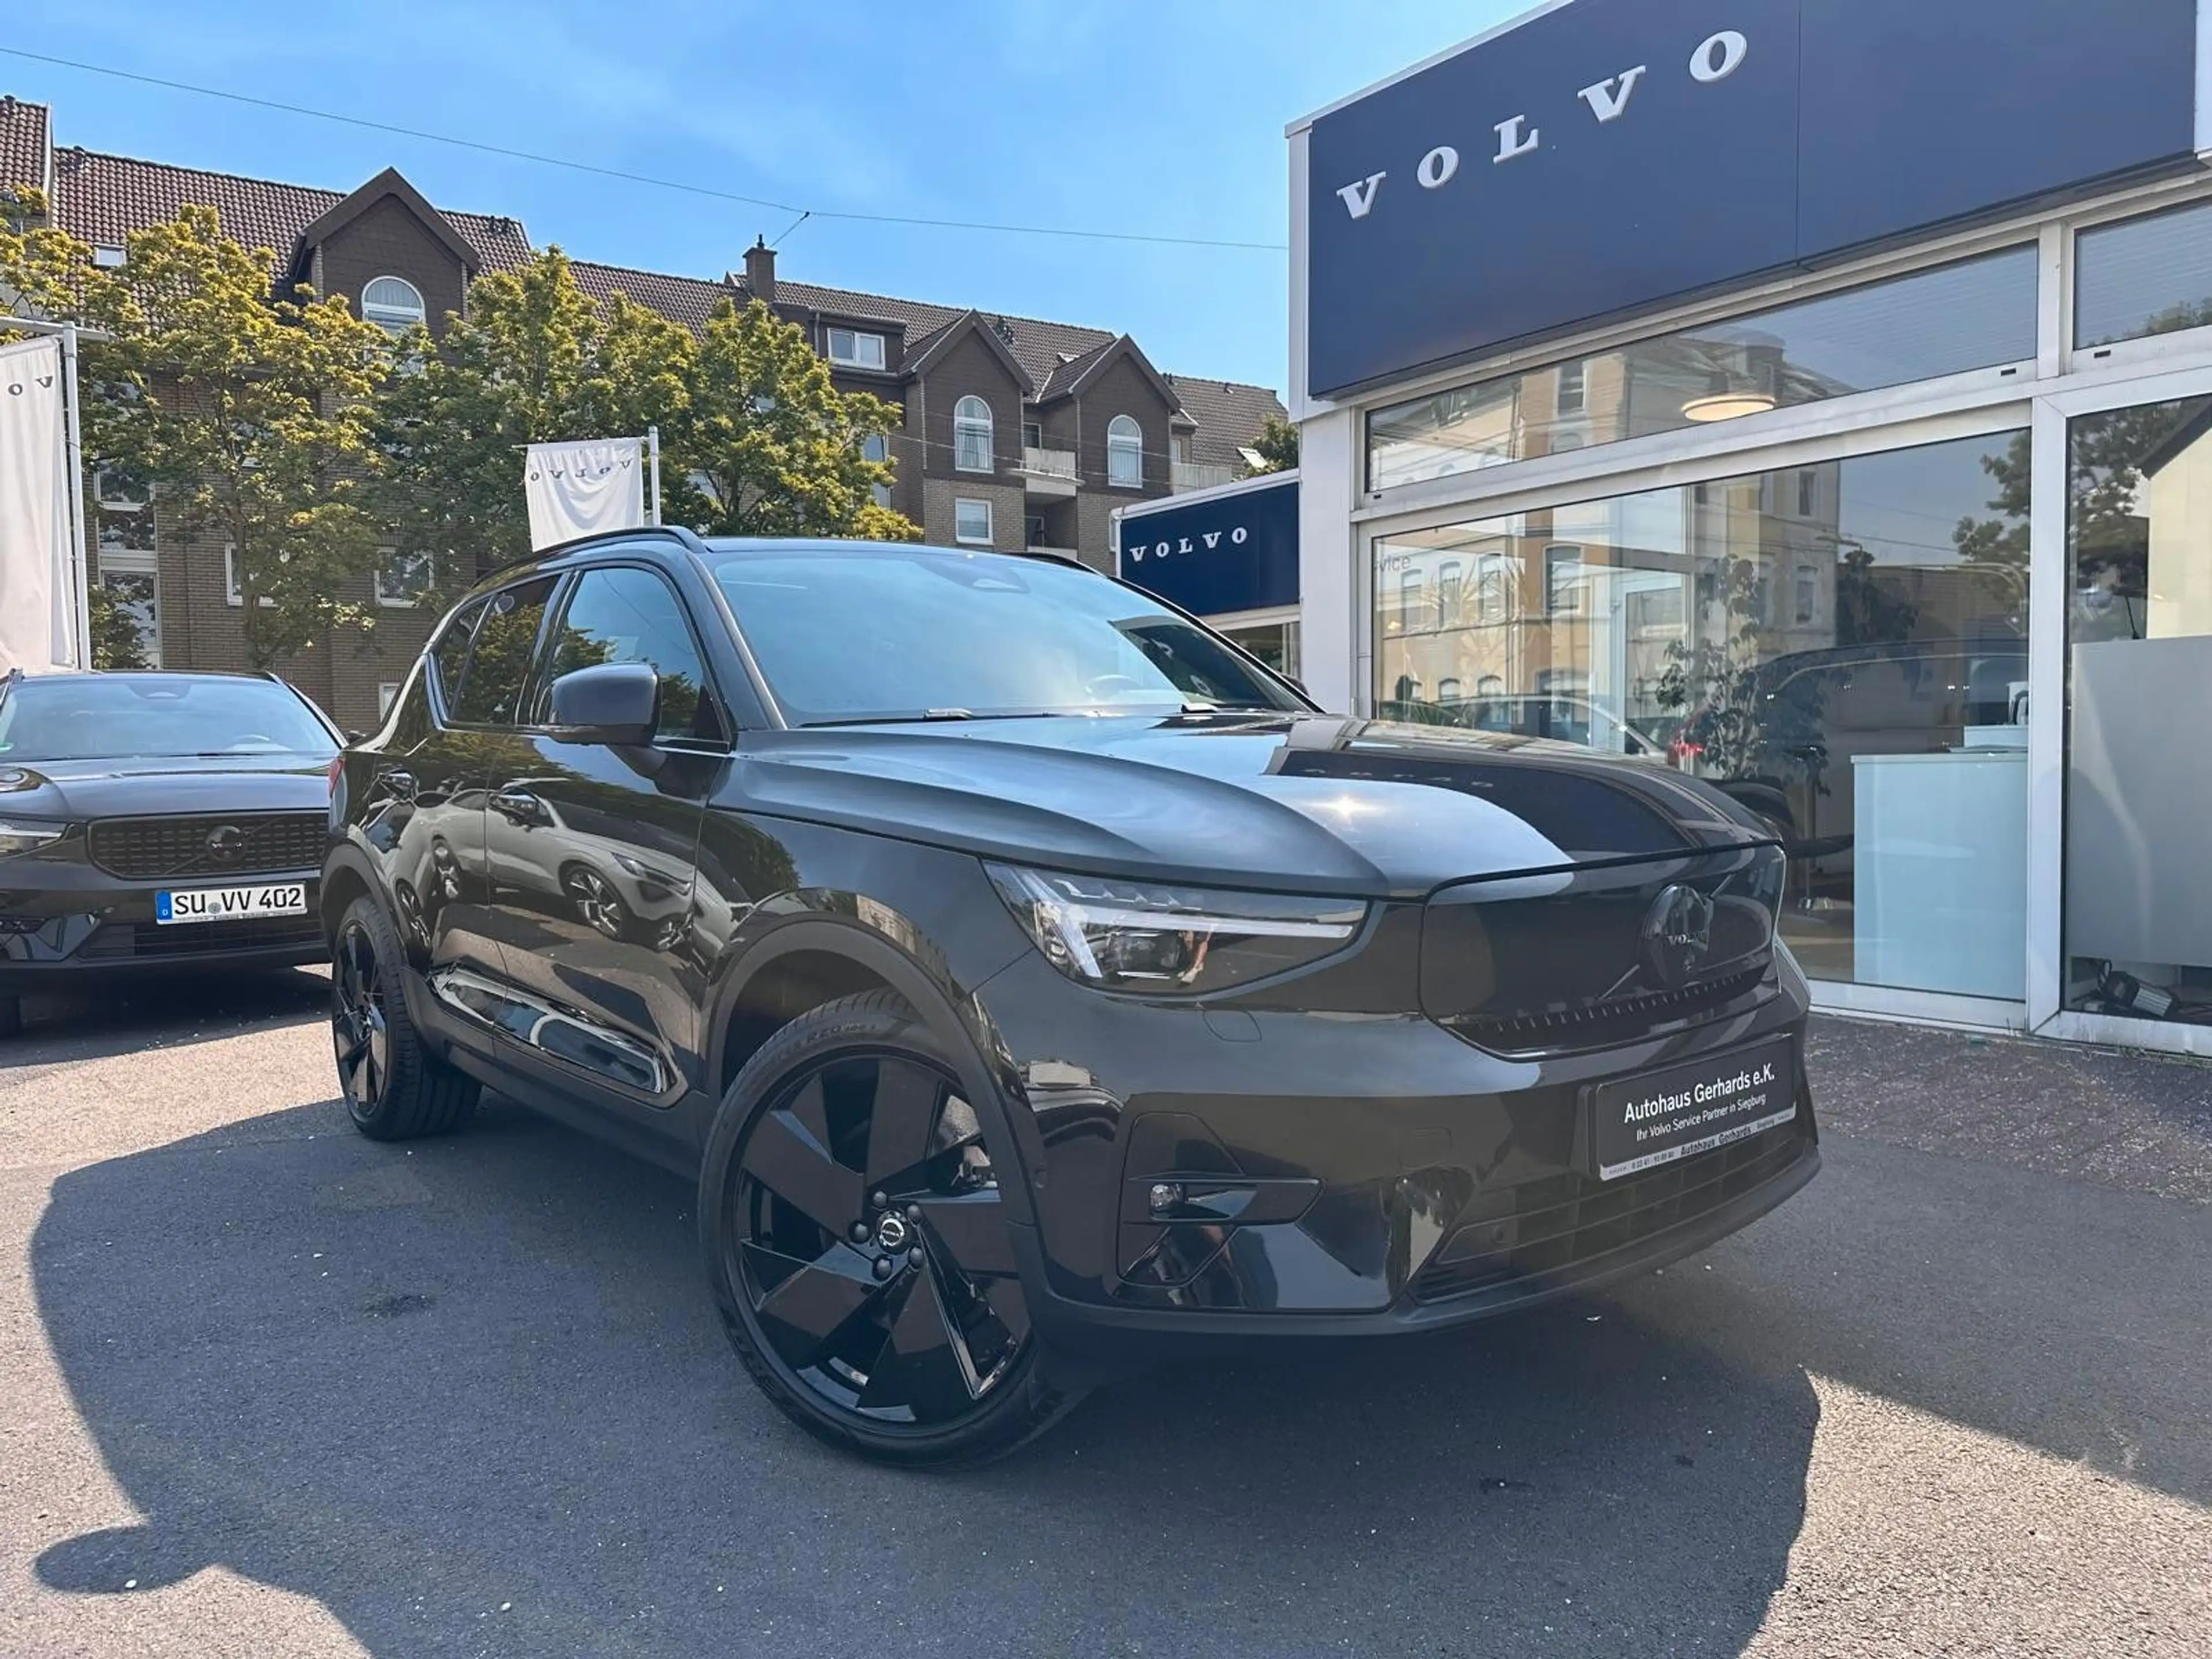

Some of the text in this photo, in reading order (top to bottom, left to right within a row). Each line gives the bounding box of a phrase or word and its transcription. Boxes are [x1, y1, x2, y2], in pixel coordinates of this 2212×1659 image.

[1336, 30, 1747, 219] VOLVO
[1130, 527, 1248, 562] VOLVO
[175, 893, 205, 915] SU
[221, 891, 251, 911] VV
[259, 888, 301, 908] 402
[1624, 1063, 1775, 1123] Autohaus Gerhards e.K.
[1637, 1128, 1648, 1142] Ihr
[1649, 1123, 1671, 1138] Volvo
[1673, 1113, 1701, 1131] Service
[1702, 1107, 1728, 1123] Partner
[1730, 1103, 1736, 1113] in
[1681, 1139, 1715, 1156] Autohaus
